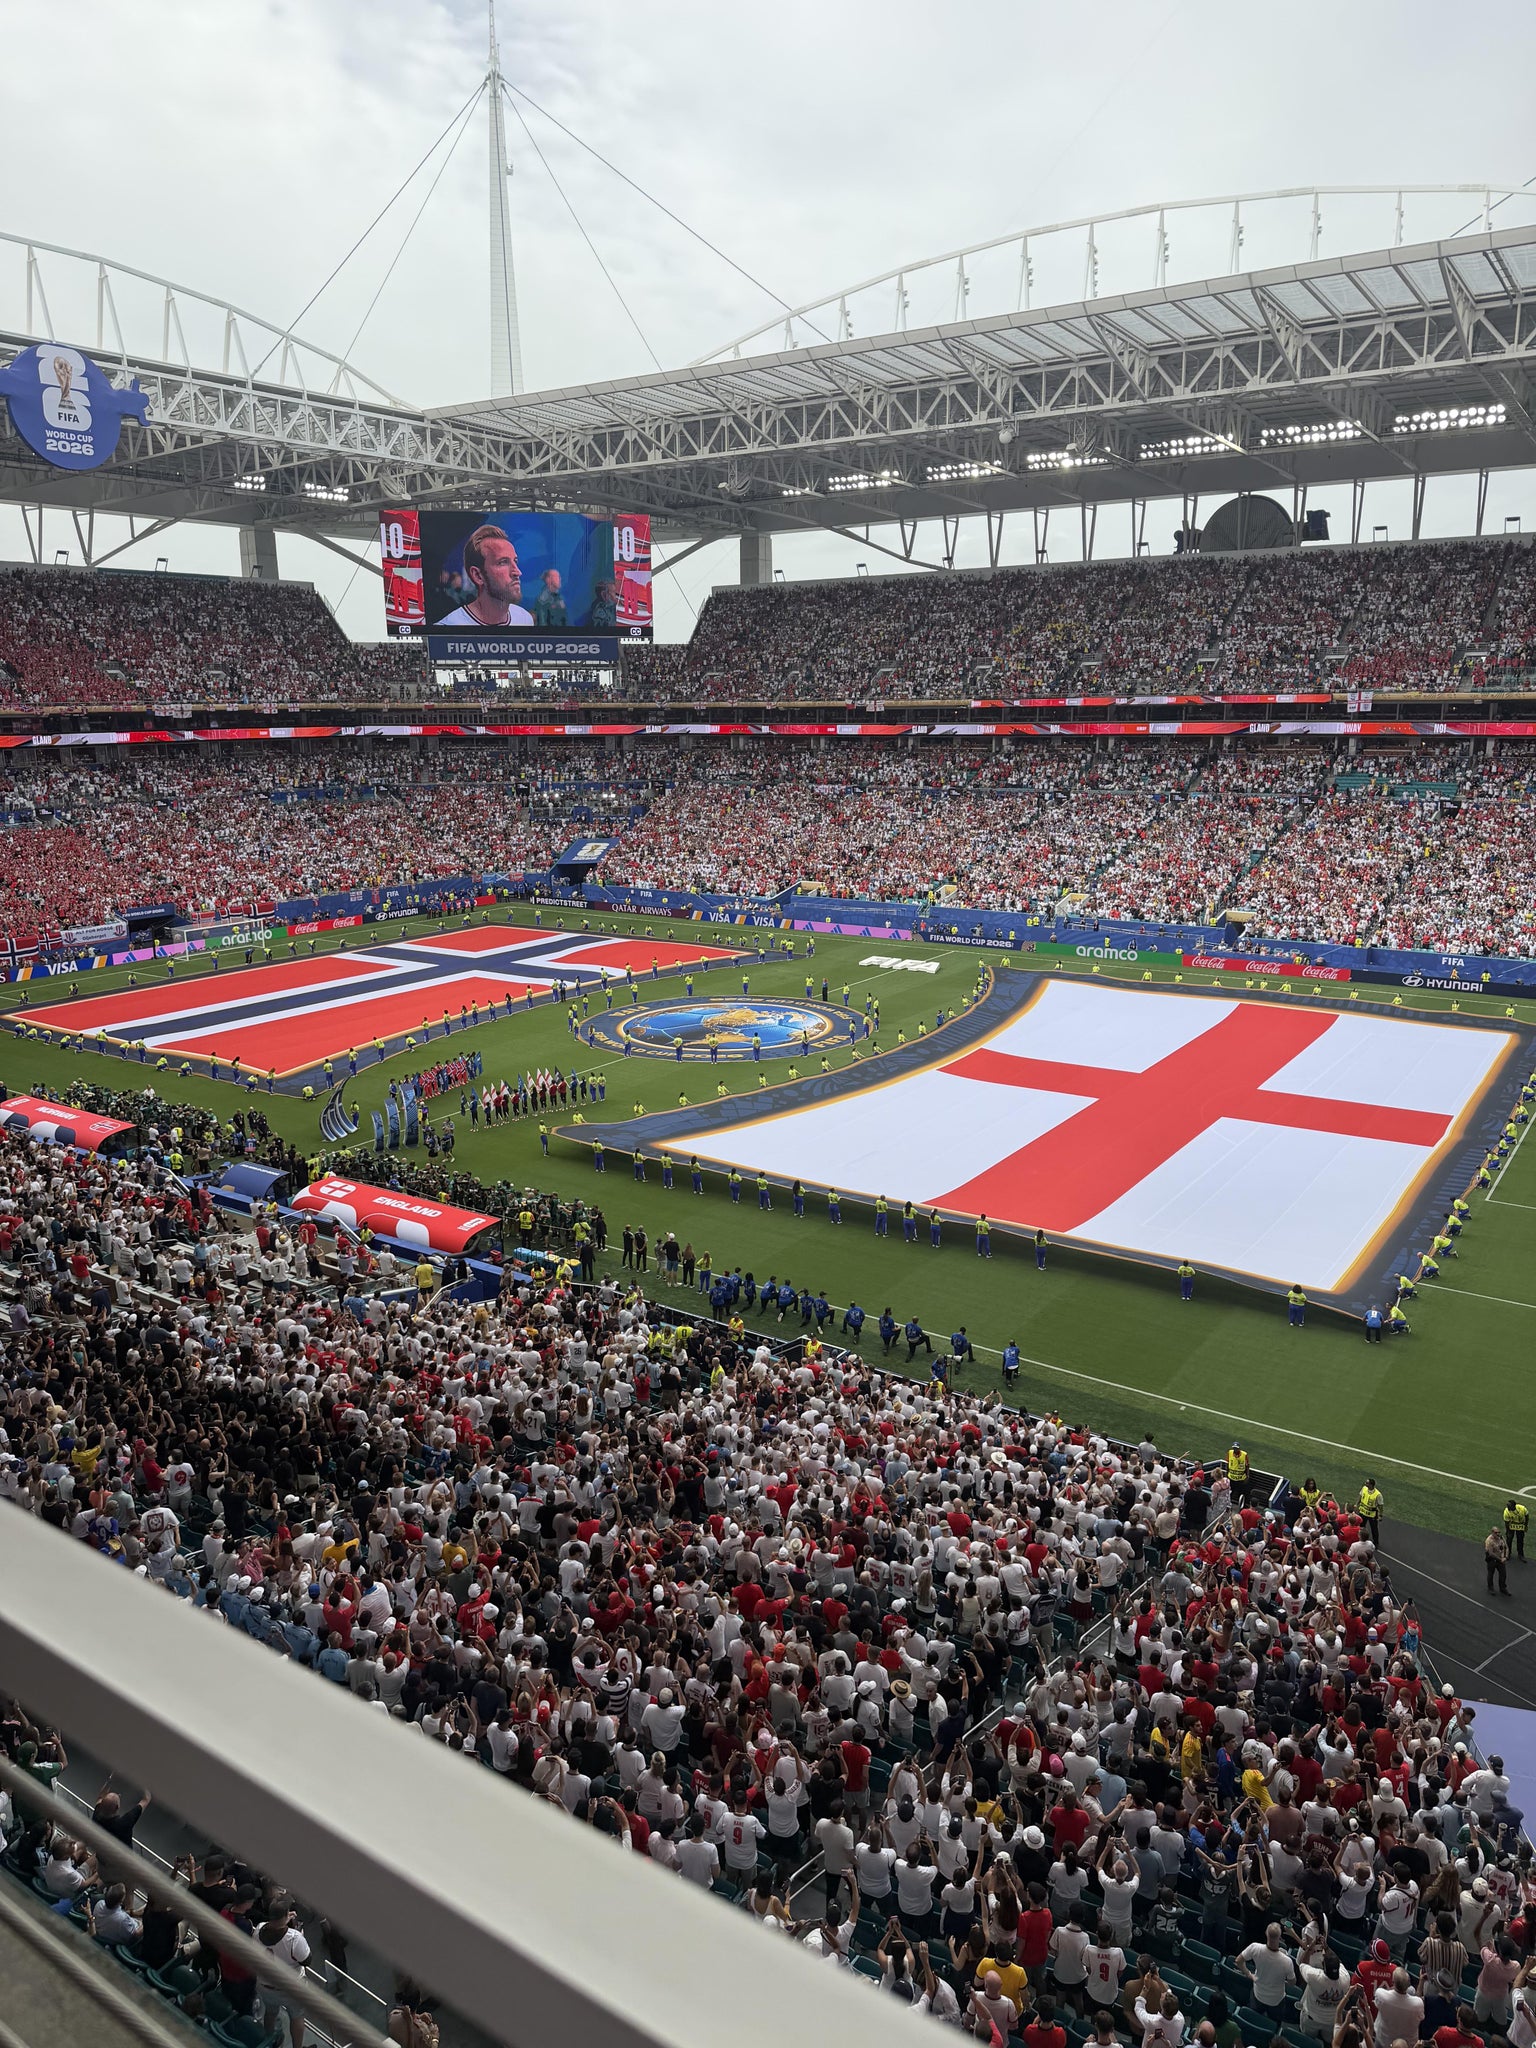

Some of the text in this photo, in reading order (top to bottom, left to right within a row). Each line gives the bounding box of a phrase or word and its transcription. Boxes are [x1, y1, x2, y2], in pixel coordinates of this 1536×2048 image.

[58, 412, 80, 424] FIFA
[45, 430, 94, 443] WORLD CUP
[46, 439, 95, 456] 2026
[447, 643, 600, 655] FIFA WORLD CUP 2026
[536, 897, 589, 908] PREDICTSTREET
[388, 907, 419, 918] HYUNDAI
[611, 904, 672, 917] QATAR AIRWAYS
[708, 911, 731, 923] VISA
[752, 916, 775, 928] VISA
[929, 934, 944, 942] FIFA
[944, 935, 971, 945] WORLD
[972, 938, 986, 946] CUP
[1076, 945, 1138, 961] aramco
[45, 960, 79, 976] VISA
[858, 955, 940, 974] FIFA
[1441, 957, 1465, 967] FIFA
[1427, 978, 1483, 992] HYUNDAI
[35, 1106, 80, 1120] NORWAY
[372, 1196, 443, 1218] ENGLAND
[527, 1416, 538, 1429] 21
[893, 1572, 905, 1587] 26
[620, 1657, 628, 1672] 6
[1395, 1781, 1403, 1796] 4
[733, 1827, 742, 1845] 9
[1155, 1914, 1176, 1932] 26
[1099, 1962, 1110, 1982] 9
